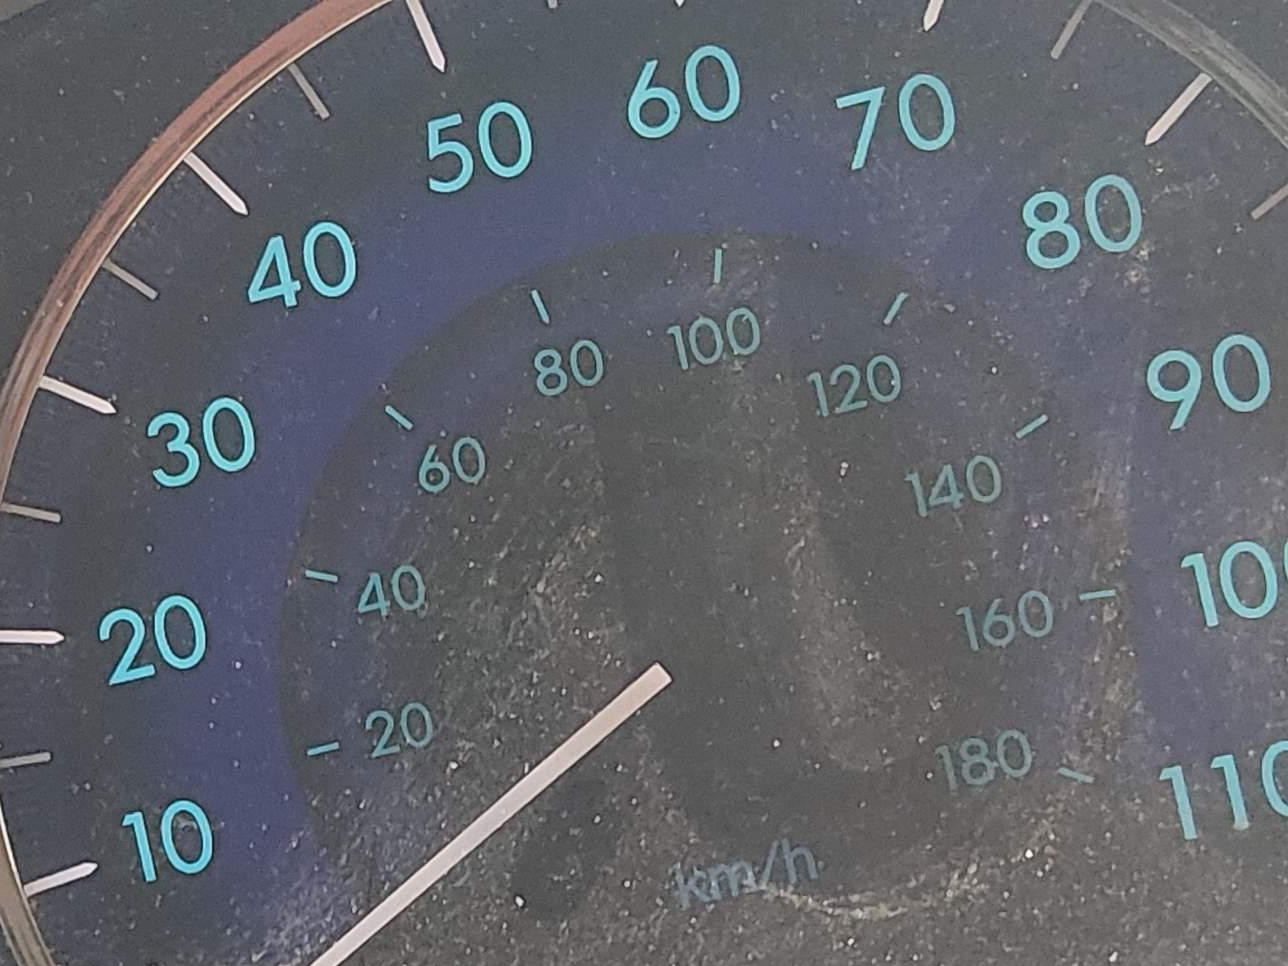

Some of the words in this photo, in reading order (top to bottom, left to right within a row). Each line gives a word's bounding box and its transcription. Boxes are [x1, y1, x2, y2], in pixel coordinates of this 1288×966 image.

[628, 46, 740, 137] 60
[837, 74, 955, 169] 70
[428, 100, 532, 192] 50
[1023, 176, 1141, 268] 80
[248, 222, 356, 306] 40
[535, 340, 603, 396] 80
[669, 307, 759, 368] 100
[811, 356, 902, 416] 120
[1147, 335, 1270, 428] 90
[148, 398, 254, 486] 30
[418, 437, 484, 493] 60
[907, 455, 999, 517] 140
[358, 566, 423, 613] 40
[955, 590, 1054, 651] 160
[1180, 539, 1288, 627] 10
[99, 595, 205, 683] 20
[364, 704, 431, 757] 20
[935, 729, 1032, 796] 180
[123, 800, 212, 881] 10
[670, 838, 819, 911] km/h
